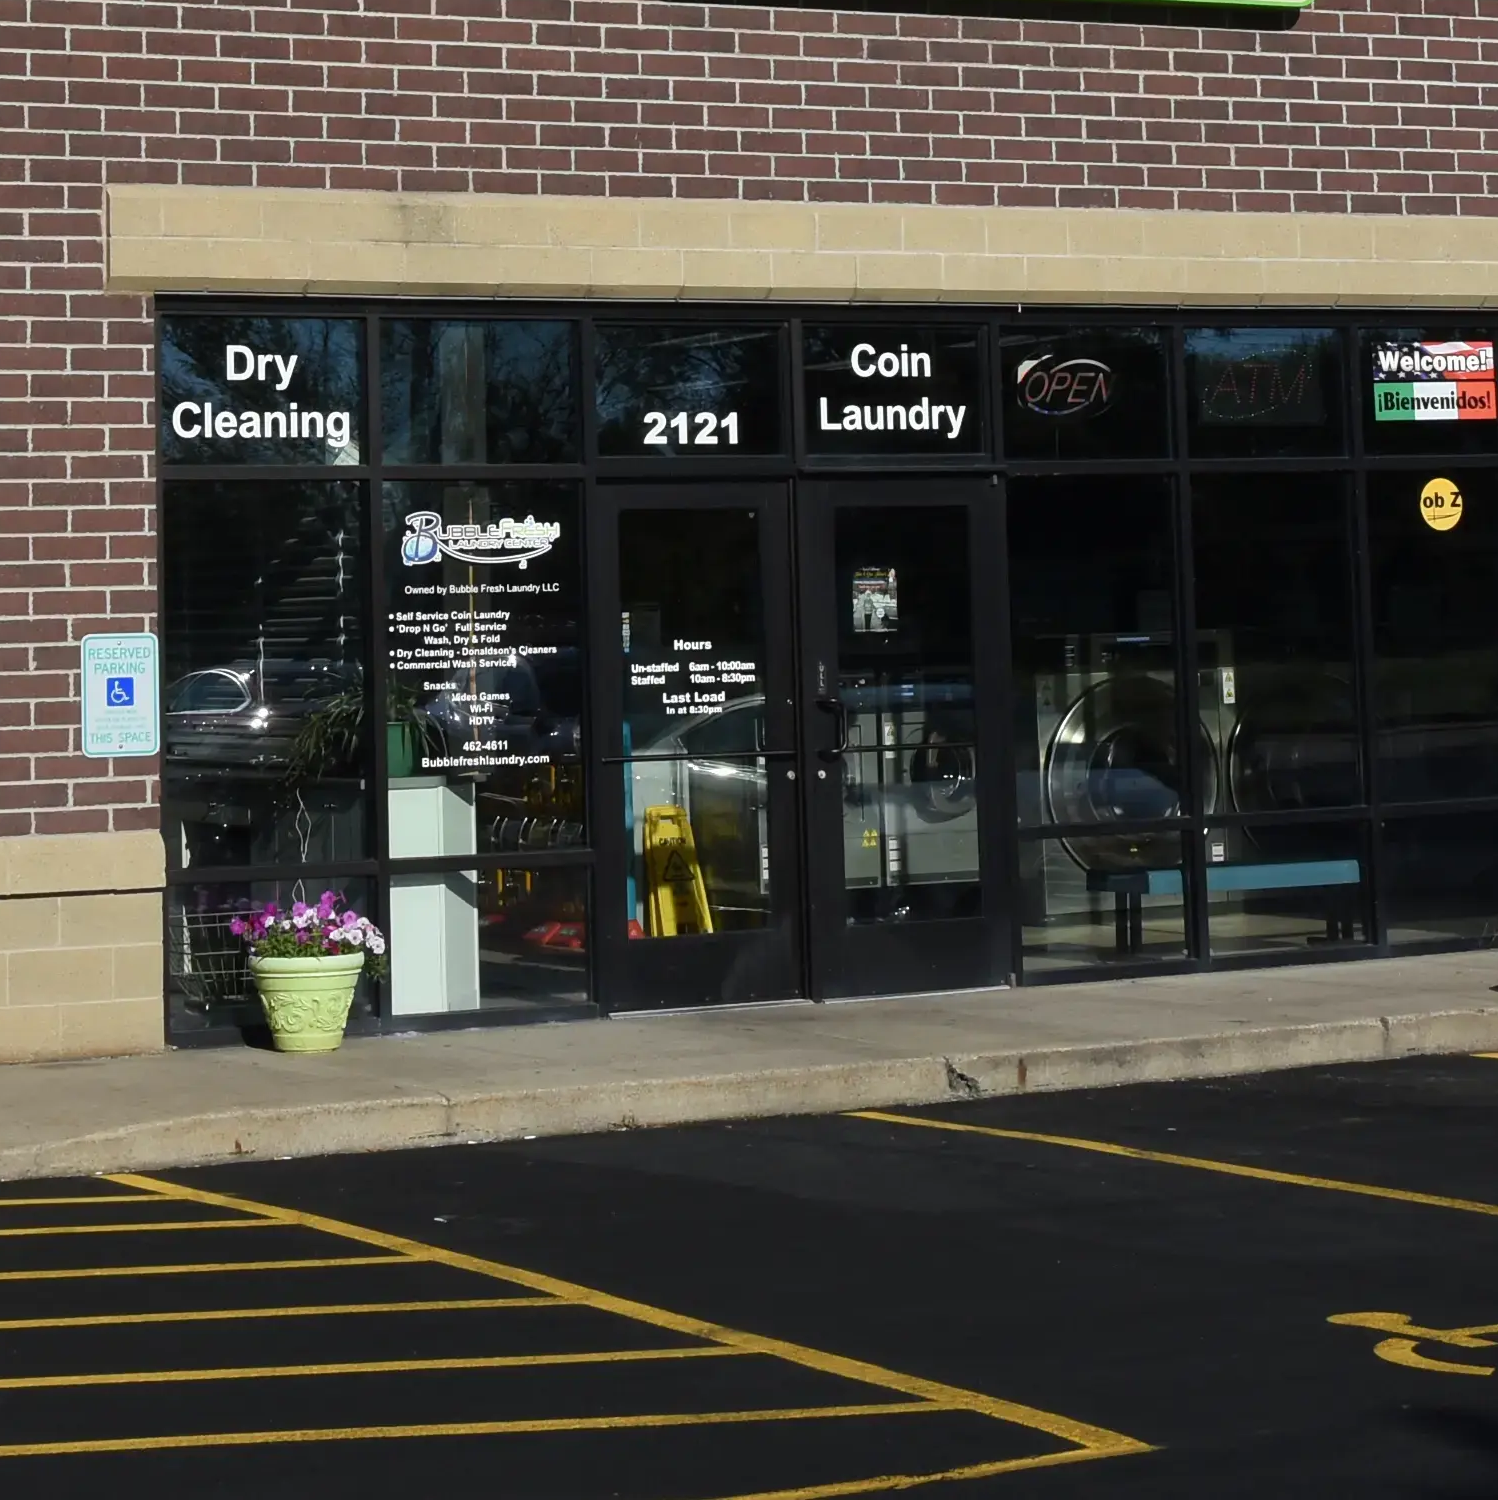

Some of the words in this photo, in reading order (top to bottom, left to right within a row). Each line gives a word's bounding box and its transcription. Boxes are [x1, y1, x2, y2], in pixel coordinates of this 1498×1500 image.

[851, 343, 931, 378] Coin
[1378, 350, 1487, 372] Welcome!
[226, 345, 299, 391] Dry
[1025, 371, 1113, 403] OPEN
[1211, 364, 1305, 403] ATM
[1378, 391, 1491, 412] ¡Bienvenidos!
[819, 397, 966, 438] Laundry
[172, 402, 350, 447] Cleaning
[643, 411, 738, 445] 2121
[1423, 492, 1445, 508] ob
[449, 538, 504, 550] LAUNDRY
[504, 537, 549, 548] CENTER
[405, 585, 435, 594] Owned
[437, 585, 447, 596] by
[450, 584, 478, 594] Bubble
[481, 583, 504, 593] Fresh
[507, 583, 540, 595] Laundry
[542, 583, 559, 592] LLC
[396, 612, 413, 621] Self
[416, 611, 448, 620] Service
[451, 611, 472, 619] Coin
[474, 610, 510, 621] Laundry
[423, 624, 430, 632] N
[455, 623, 472, 632] Full
[474, 622, 507, 631] Service
[424, 636, 451, 645] Wash,
[454, 635, 468, 645] Dry
[472, 635, 478, 643] &
[481, 634, 500, 643] Fold
[673, 639, 712, 650] Hours
[88, 647, 151, 660] RESERVED
[397, 649, 412, 659] Dry
[415, 648, 454, 659] Cleaning
[462, 646, 516, 656] Donaldson's
[519, 645, 558, 655] Cleaners
[94, 662, 146, 675] PARKING
[397, 661, 450, 670] Commercial
[452, 660, 476, 669] Wash
[631, 662, 679, 673] Un-staffed
[688, 662, 709, 672] 6am
[716, 661, 755, 671] 10:00am
[631, 675, 665, 685] Staffed
[689, 674, 715, 683] 10am
[722, 673, 755, 684] 8:30pm
[423, 682, 457, 690] Snacks
[479, 692, 510, 701] Games
[662, 692, 691, 703] Last
[694, 691, 725, 702] Load
[469, 704, 493, 713] Wi-Fi
[666, 706, 675, 714] In
[678, 706, 687, 714] at
[689, 705, 722, 715] 8:30pm
[469, 716, 494, 725] HDTV
[89, 732, 113, 744] THIS
[118, 731, 152, 743] SPACE
[463, 740, 508, 751] 462-4611
[421, 754, 550, 768] Bubblefreshlaundry.com
